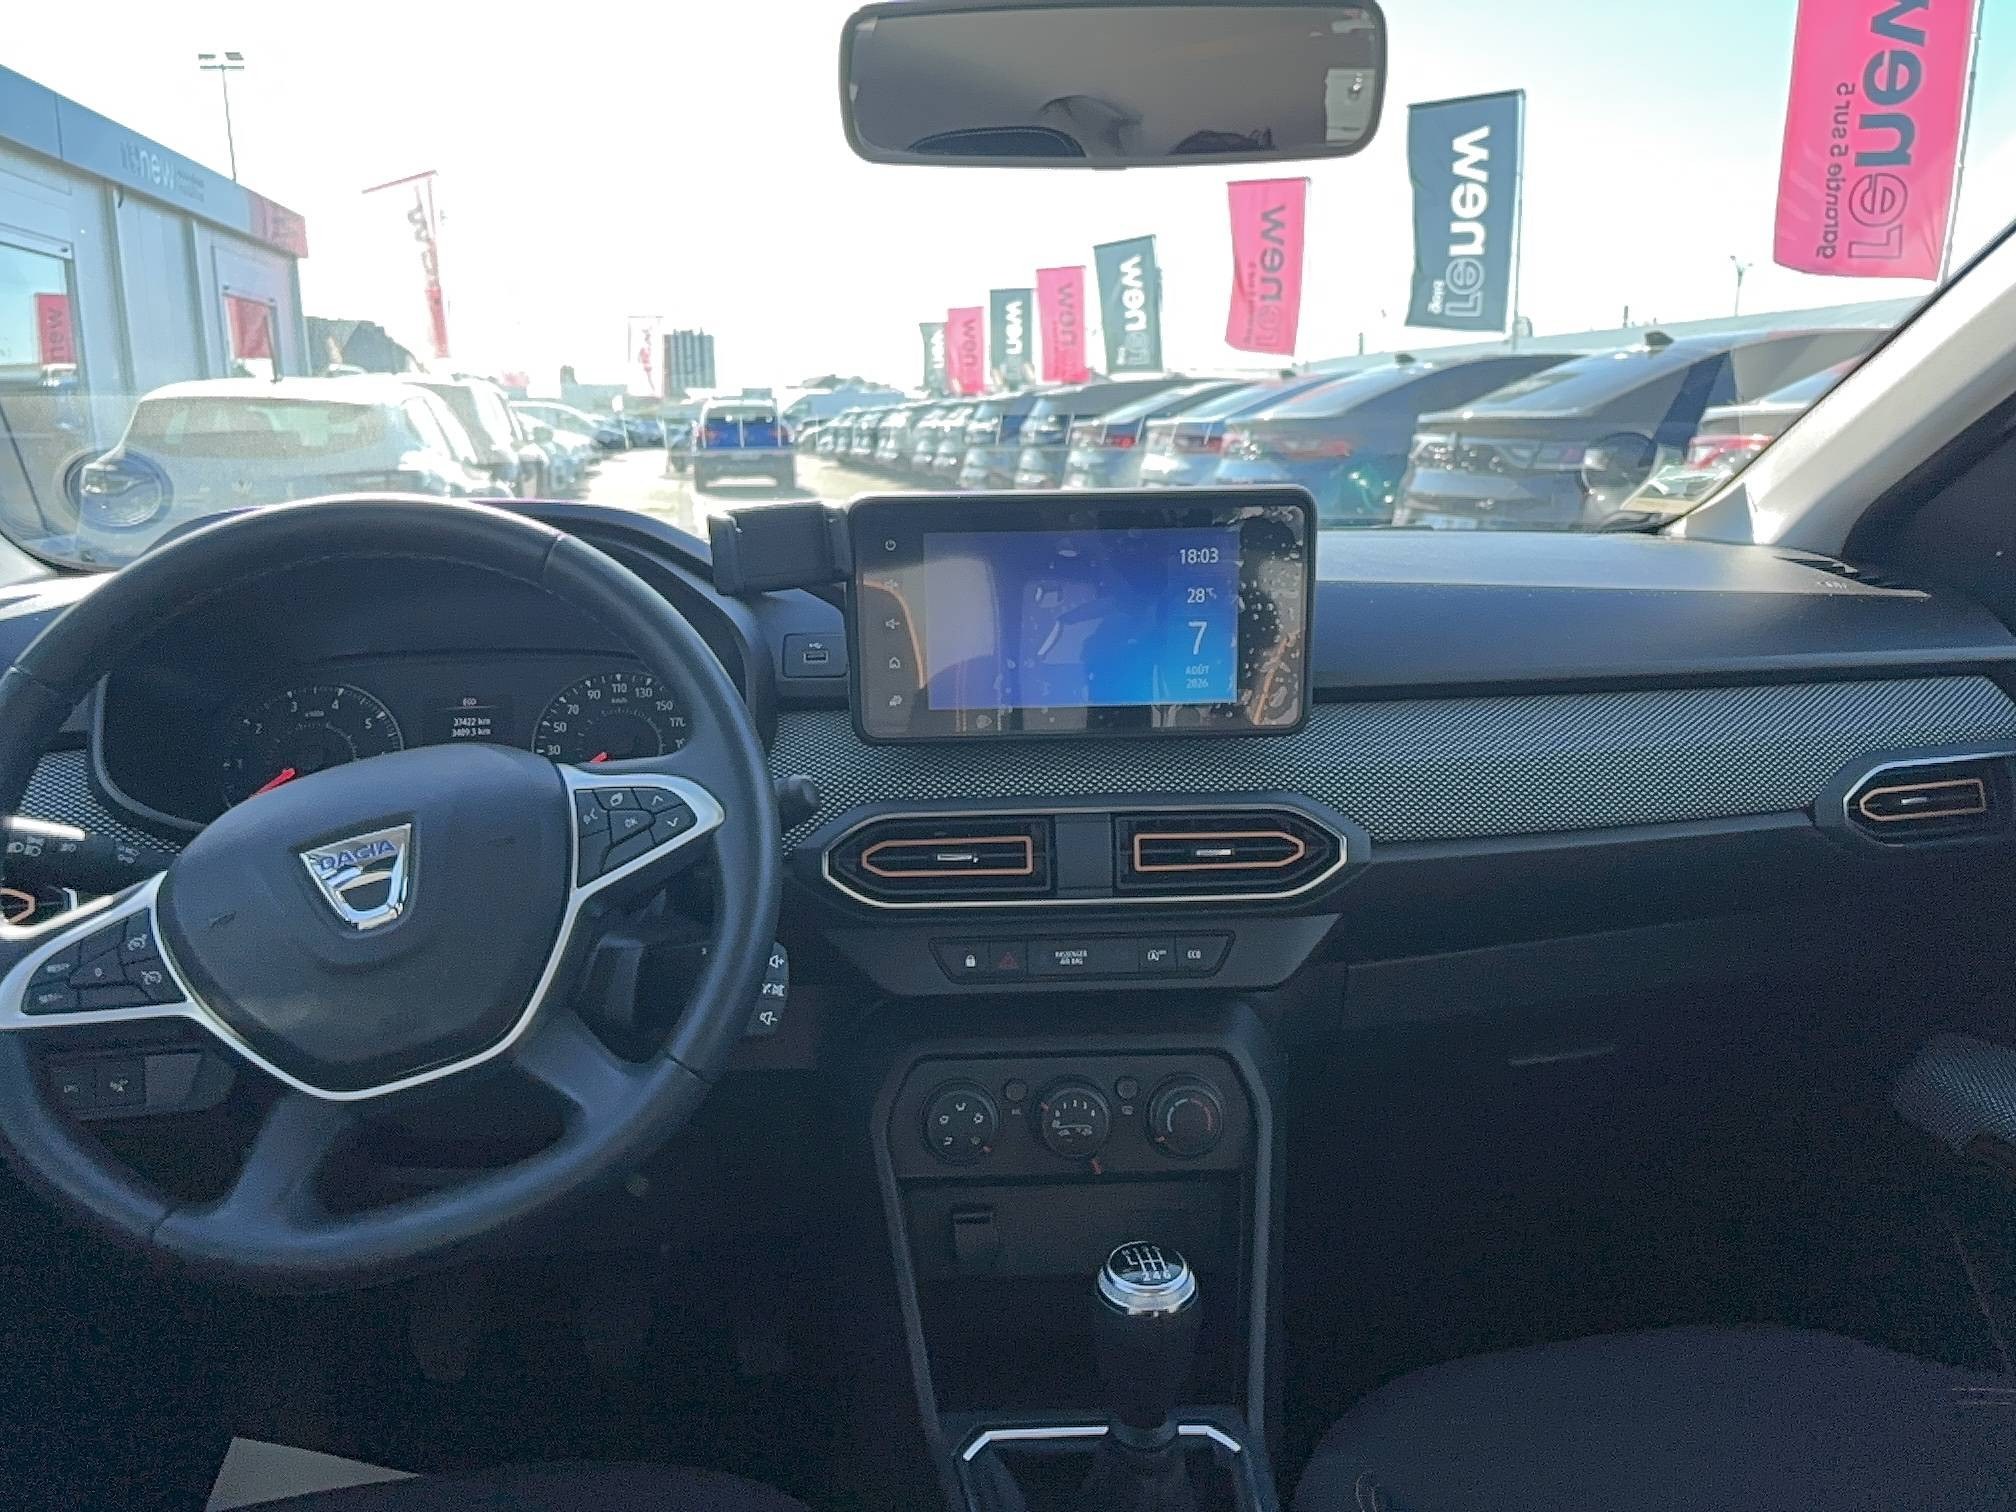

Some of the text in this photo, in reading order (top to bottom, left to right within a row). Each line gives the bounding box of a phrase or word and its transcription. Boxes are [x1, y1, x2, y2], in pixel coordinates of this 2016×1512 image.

[1179, 547, 1219, 564] 18:03
[1188, 620, 1208, 656] 7
[611, 682, 628, 693] 110
[635, 687, 653, 698] 130
[587, 689, 601, 700] 90
[567, 704, 580, 716] 70
[656, 700, 674, 712] 150
[365, 718, 373, 730] 5
[553, 721, 567, 733] 50
[547, 744, 561, 756] 30
[320, 840, 397, 870] DACIA
